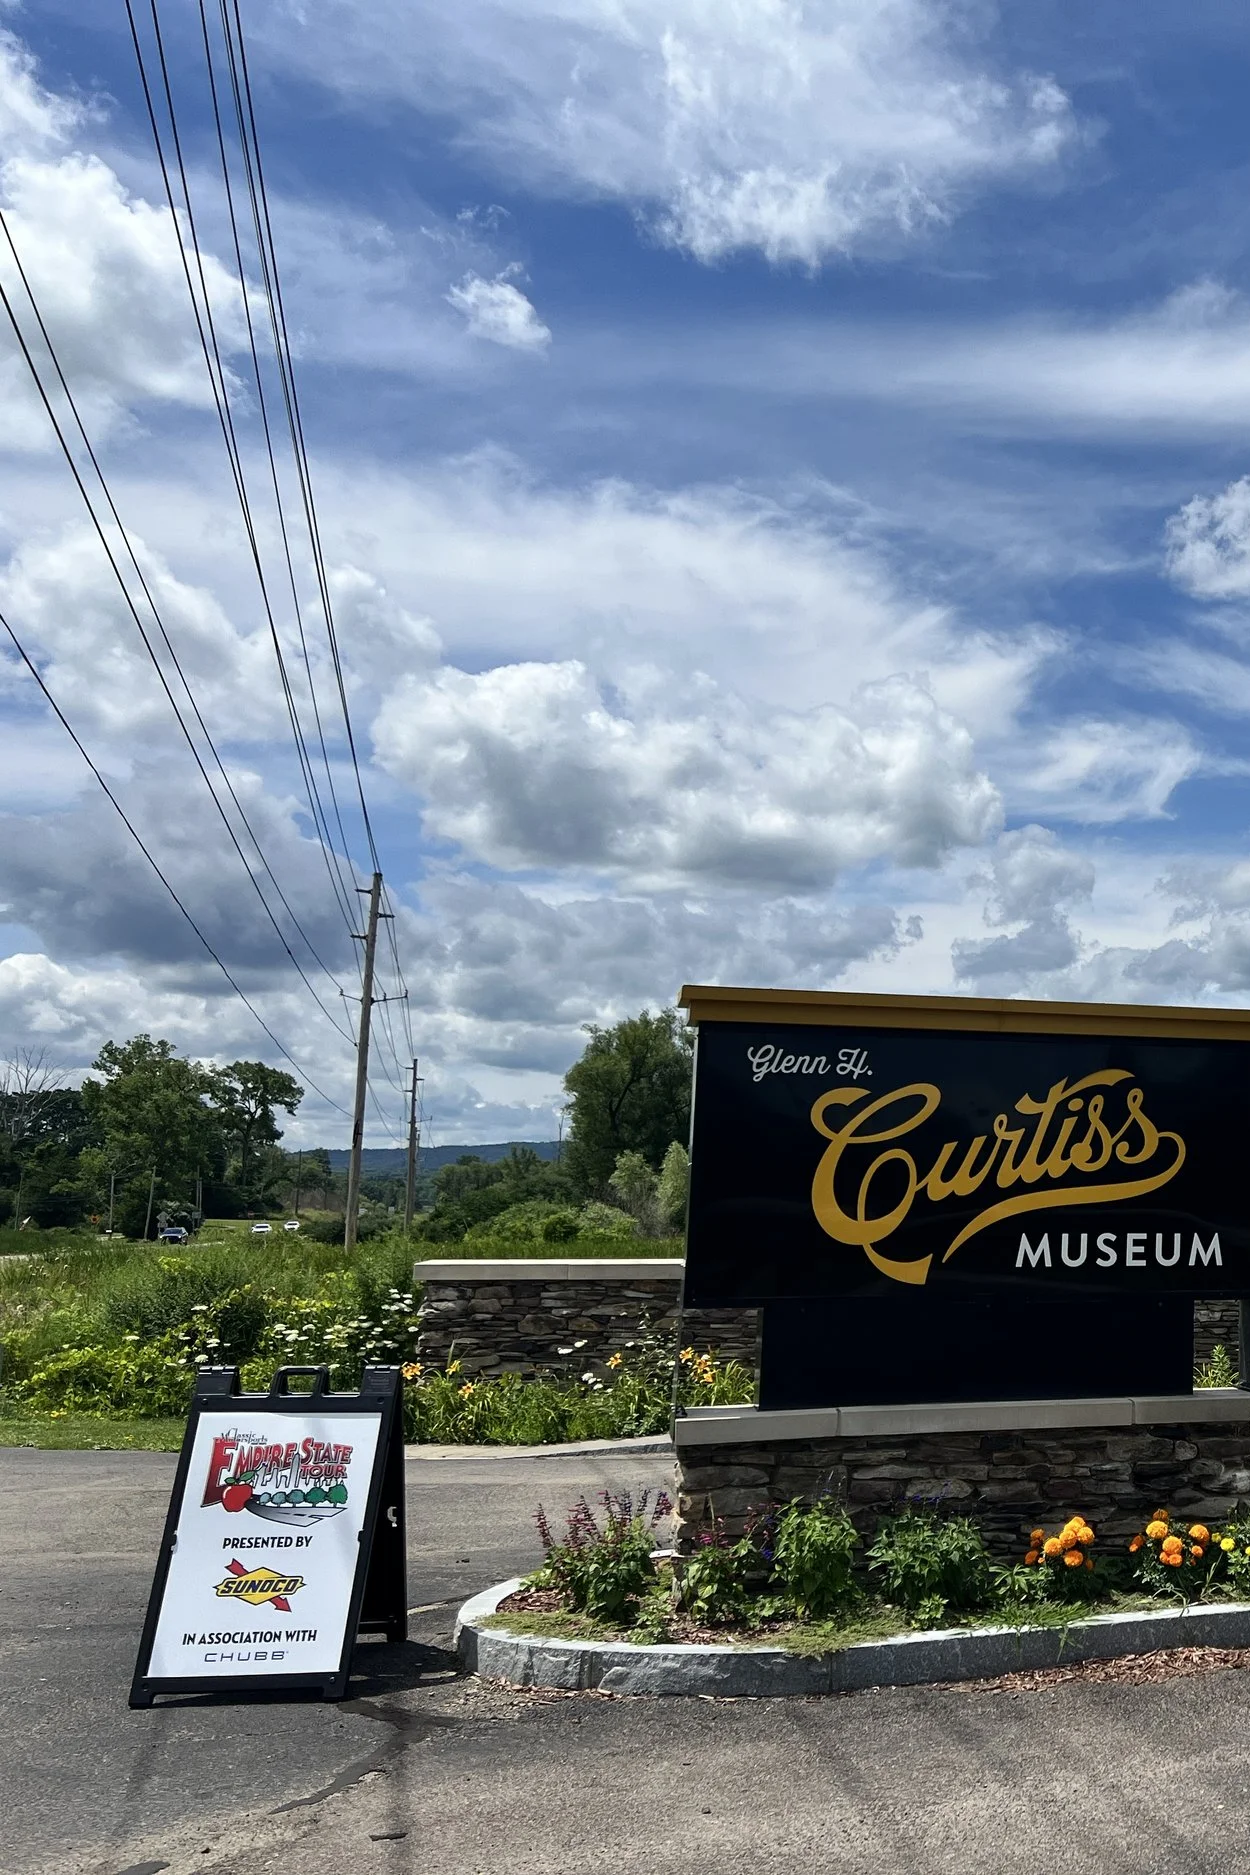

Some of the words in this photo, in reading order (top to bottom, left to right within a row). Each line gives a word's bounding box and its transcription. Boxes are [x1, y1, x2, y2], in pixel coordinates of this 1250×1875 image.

[747, 1044, 831, 1082] Glenn
[811, 1069, 1186, 1285] Curtiss
[1015, 1232, 1223, 1268] MUSEUM
[201, 1437, 297, 1507] EMPIRE
[300, 1437, 353, 1465] STATE
[300, 1464, 348, 1479] TOUR
[222, 1537, 293, 1549] PRESENTED
[295, 1536, 313, 1547] BY
[219, 1579, 300, 1594] SUNOCO
[182, 1633, 196, 1645] IN
[198, 1631, 282, 1645] ASSOCIATION
[285, 1630, 318, 1642] WITH
[204, 1651, 285, 1662] CHUBB
